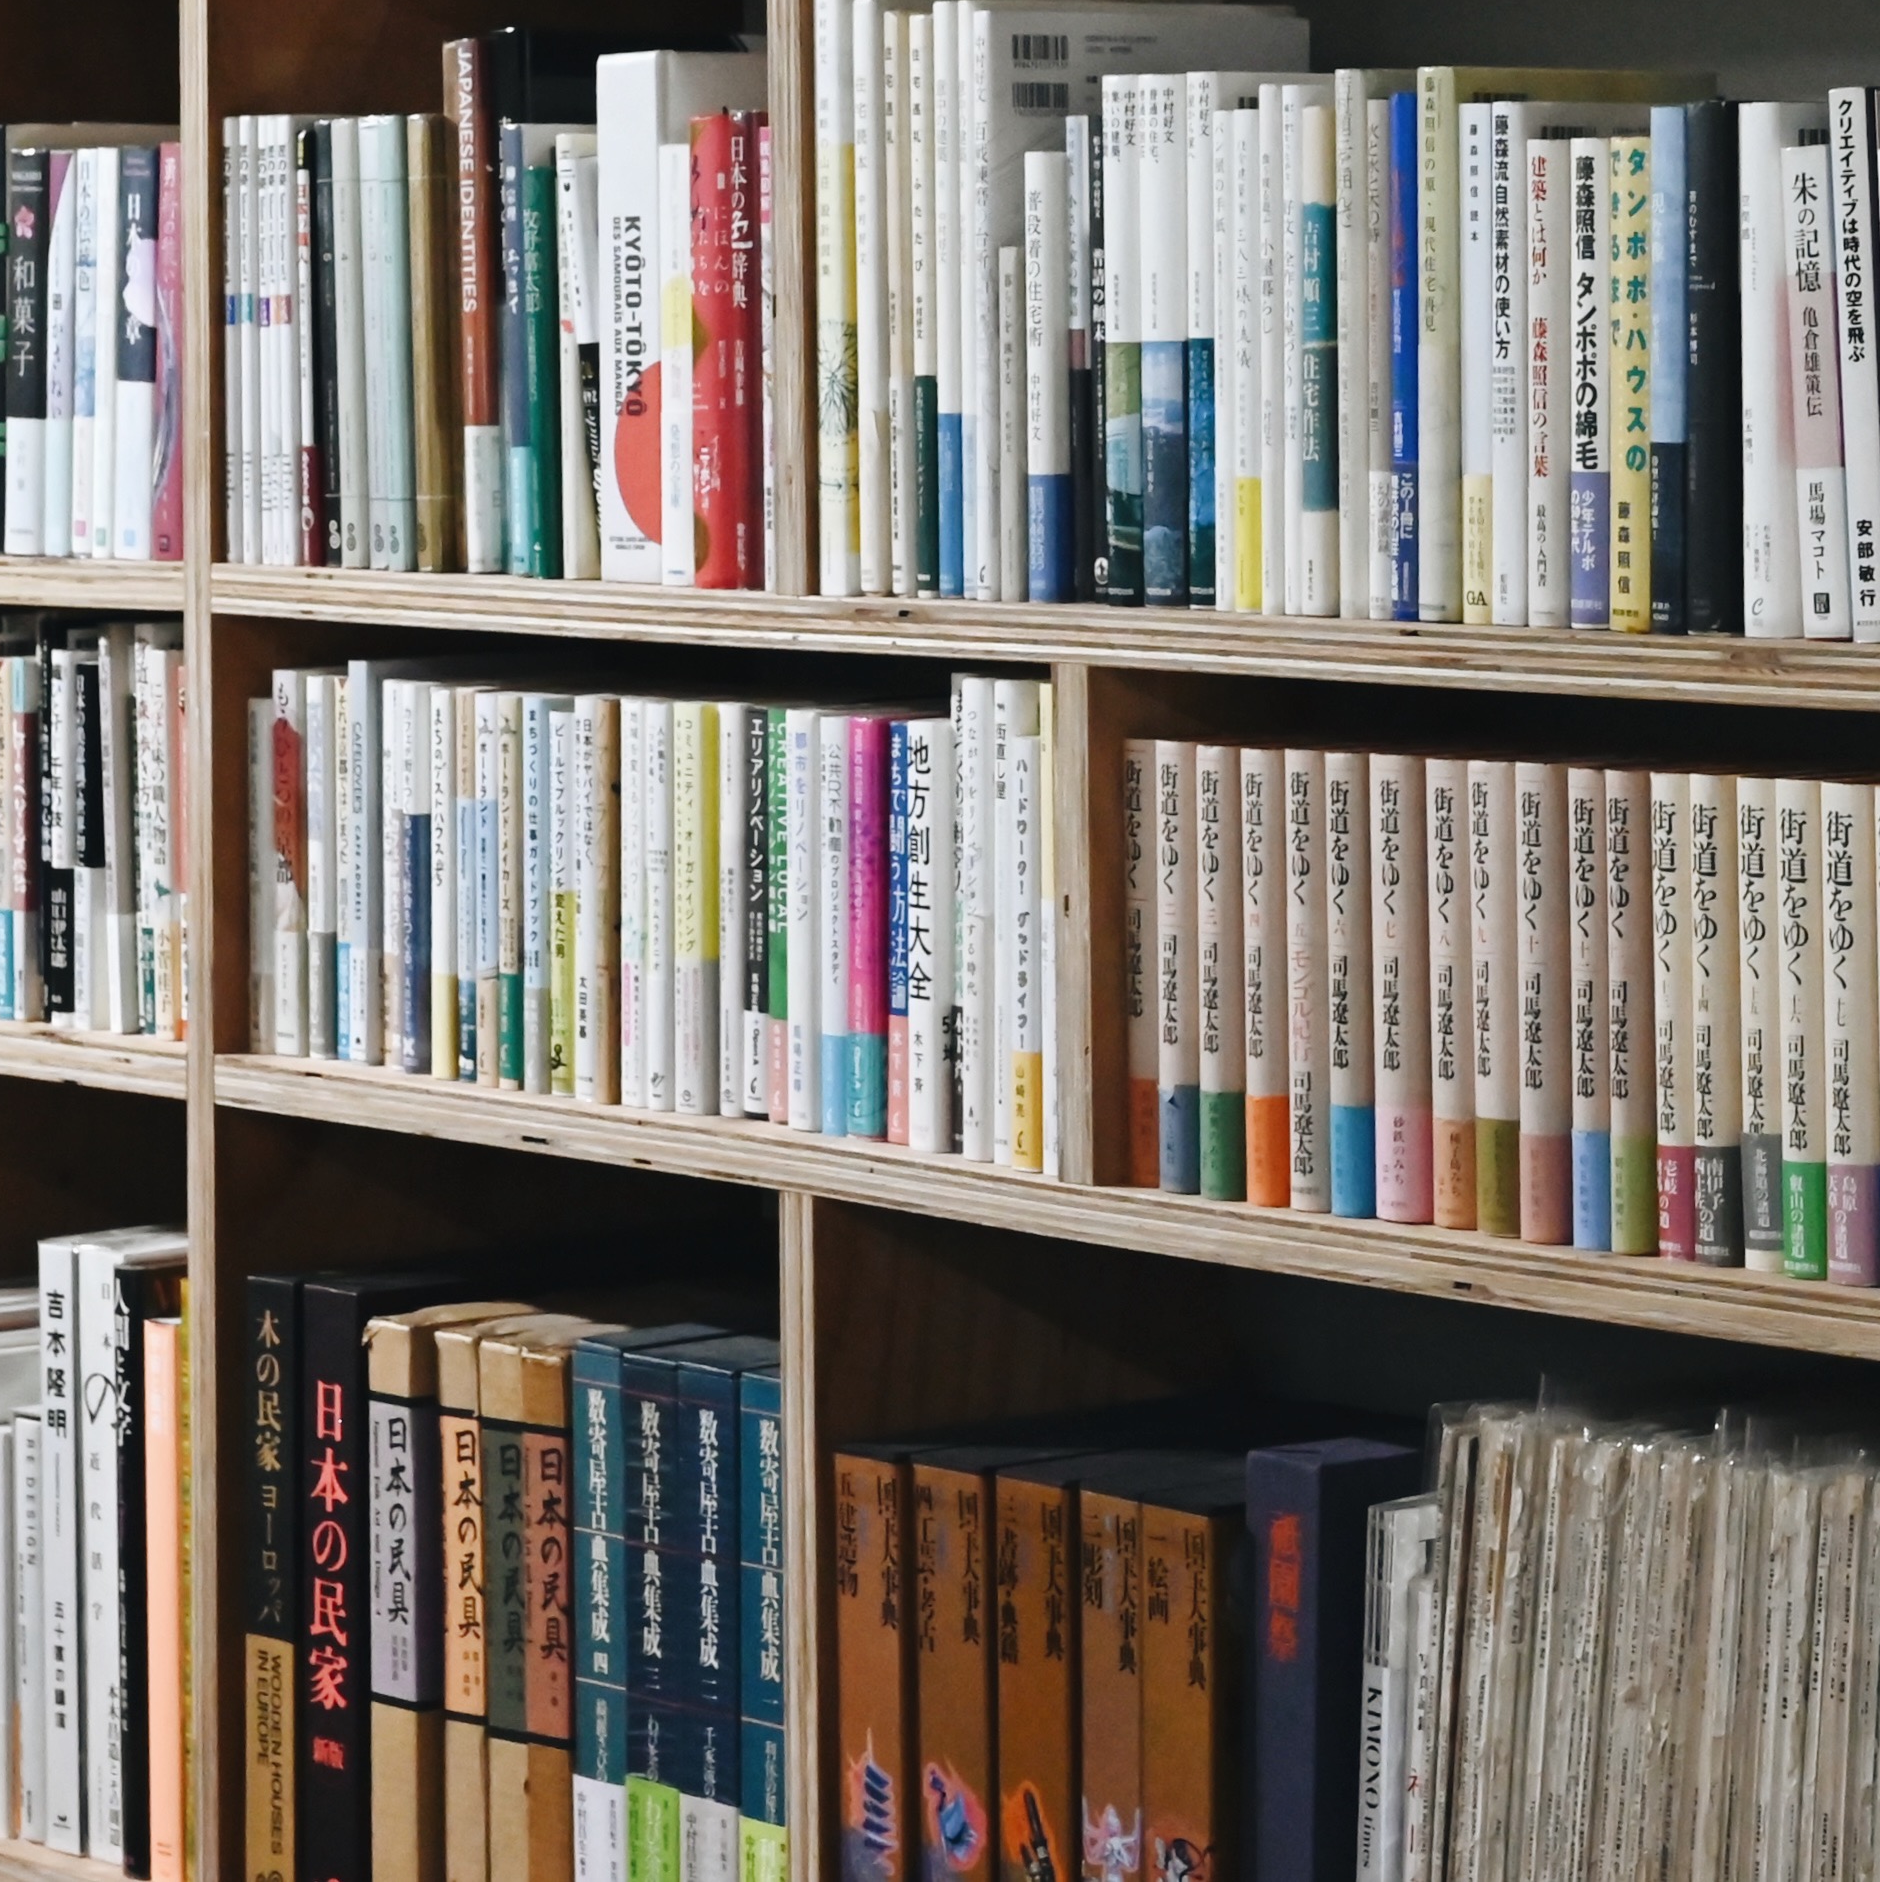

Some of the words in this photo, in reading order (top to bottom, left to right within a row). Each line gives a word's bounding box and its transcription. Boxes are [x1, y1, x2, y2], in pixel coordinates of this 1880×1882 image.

[457, 47, 479, 171] JAPANESE
[459, 177, 479, 313] IDENTITIES
[1494, 114, 1511, 360] 藤森流自然素材の使い方
[1531, 155, 1548, 285] 建築とは何か
[1575, 155, 1596, 260] 藤森照信
[1792, 171, 1821, 293] 朱の記憶
[1837, 98, 1866, 362] クリエイティブは時代の空を飛ぶ
[12, 255, 37, 379] 和菓子
[1575, 271, 1598, 472] タンポポの綿毛
[1800, 306, 1824, 419] 亀倉雄策伝
[1531, 317, 1549, 477] 藤森照信の言葉
[749, 718, 764, 903] エリアリノベーション
[907, 735, 932, 1002] 地方創生大全
[1290, 771, 1311, 906] 街道をゆく
[1381, 779, 1400, 915] 街道をゆく
[1780, 808, 1808, 986] 街道をゆく
[1383, 955, 1400, 1071] 司馬遼太郎
[1292, 1070, 1314, 1176] 司馬遼太郎
[1787, 1034, 1808, 1163] 司馬遼太郎
[45, 1289, 68, 1440] 吉本隆明
[308, 1380, 348, 1711] 日本の民家
[384, 1417, 412, 1626] 日本の民具
[454, 1429, 483, 1641] 日本の民具
[1363, 1687, 1382, 1811] KIMONO
[1361, 1816, 1376, 1869] times
